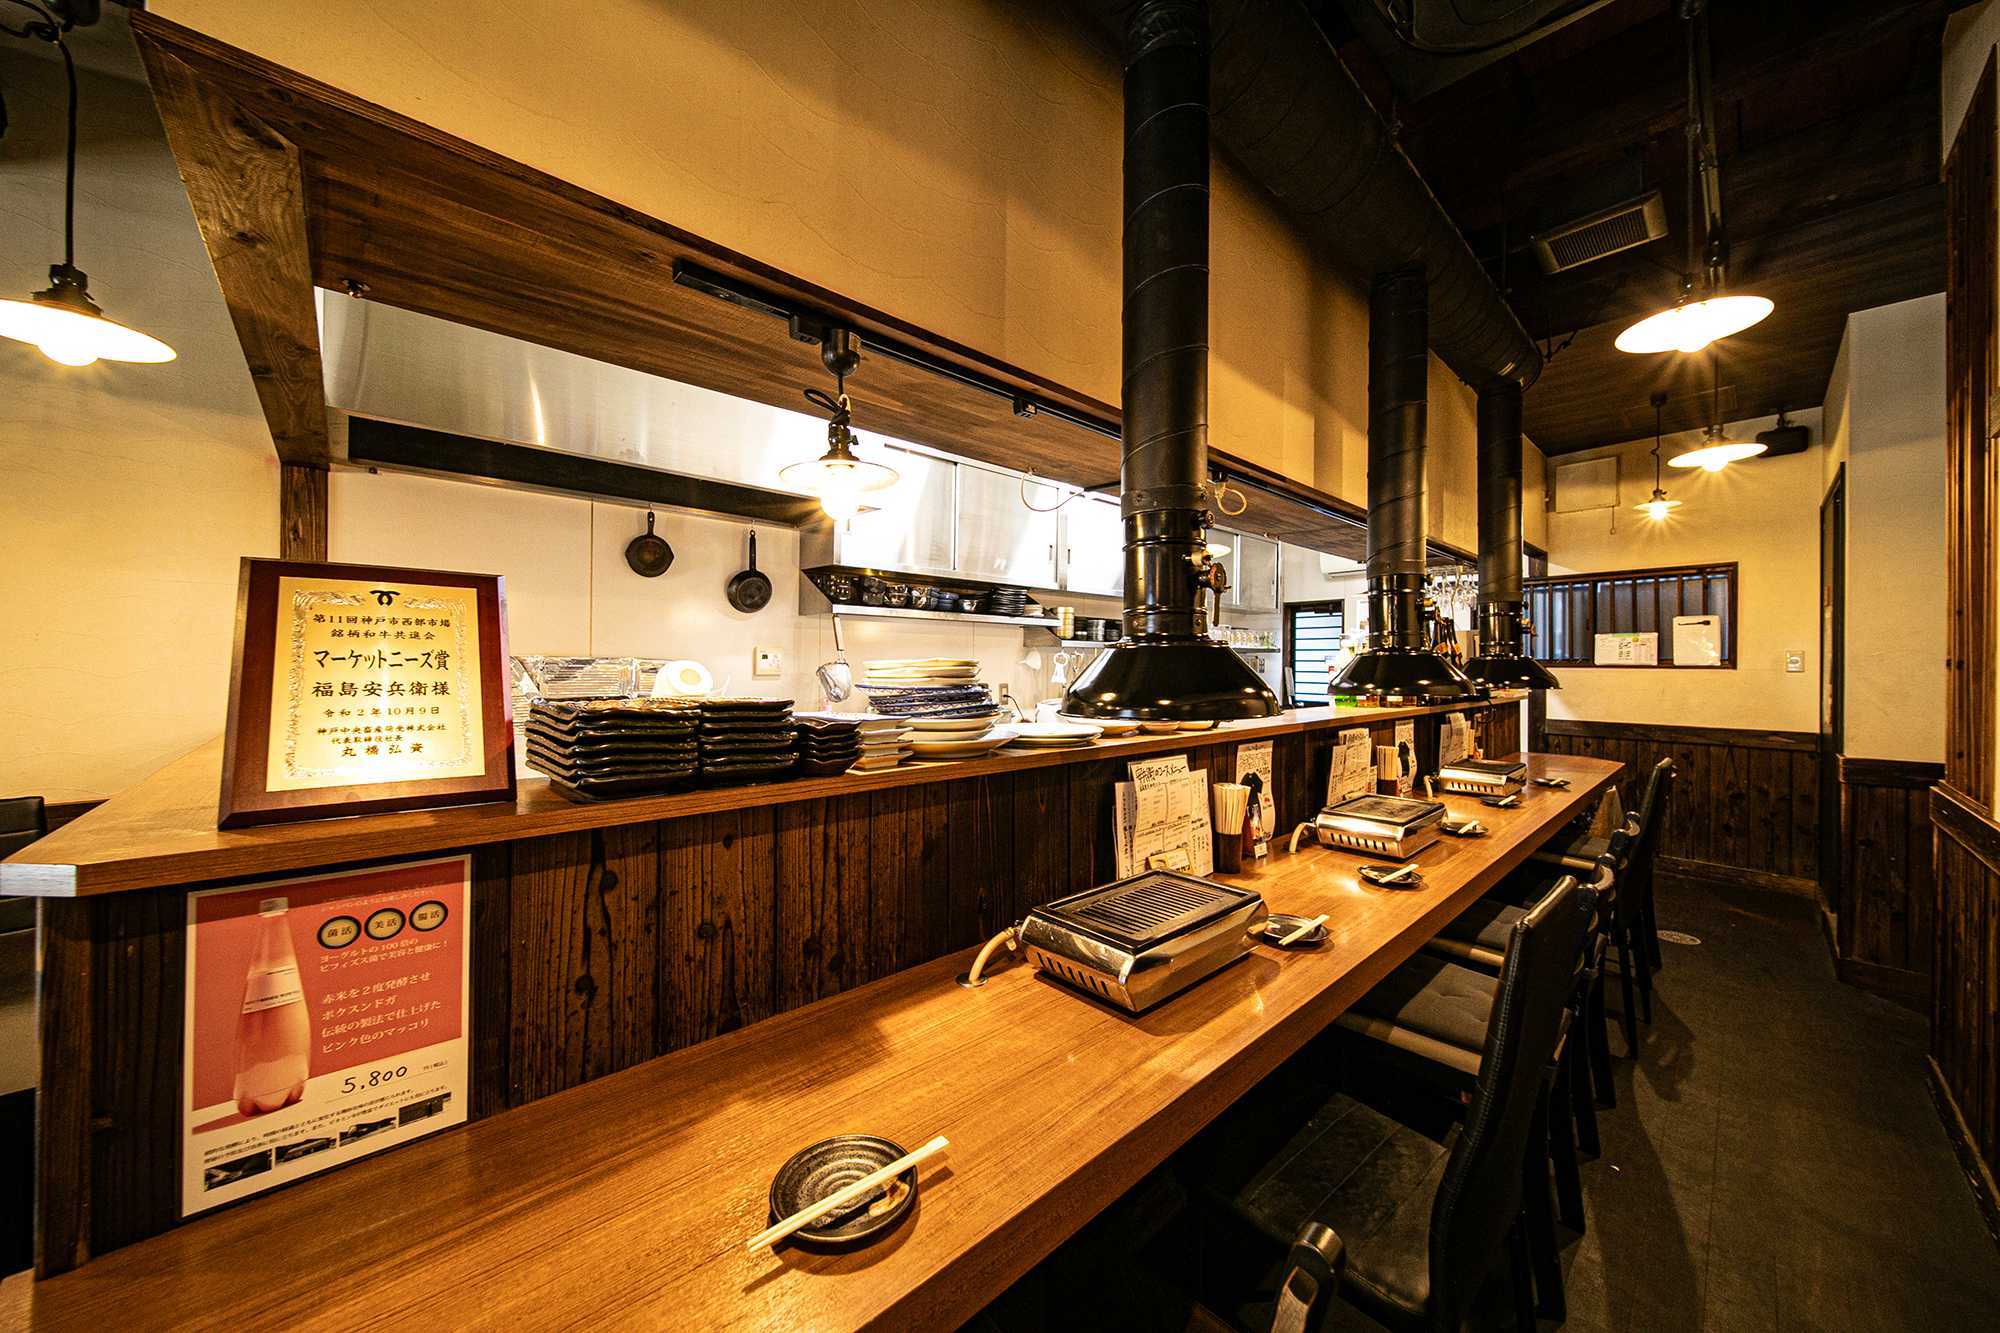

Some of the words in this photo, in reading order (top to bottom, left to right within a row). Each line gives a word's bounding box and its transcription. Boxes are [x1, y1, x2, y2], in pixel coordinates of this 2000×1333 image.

[330, 628, 436, 640] 銘柄和牛共進会
[313, 649, 450, 671] マーケットニーズ賞
[312, 681, 451, 698] 福島安兵衛様
